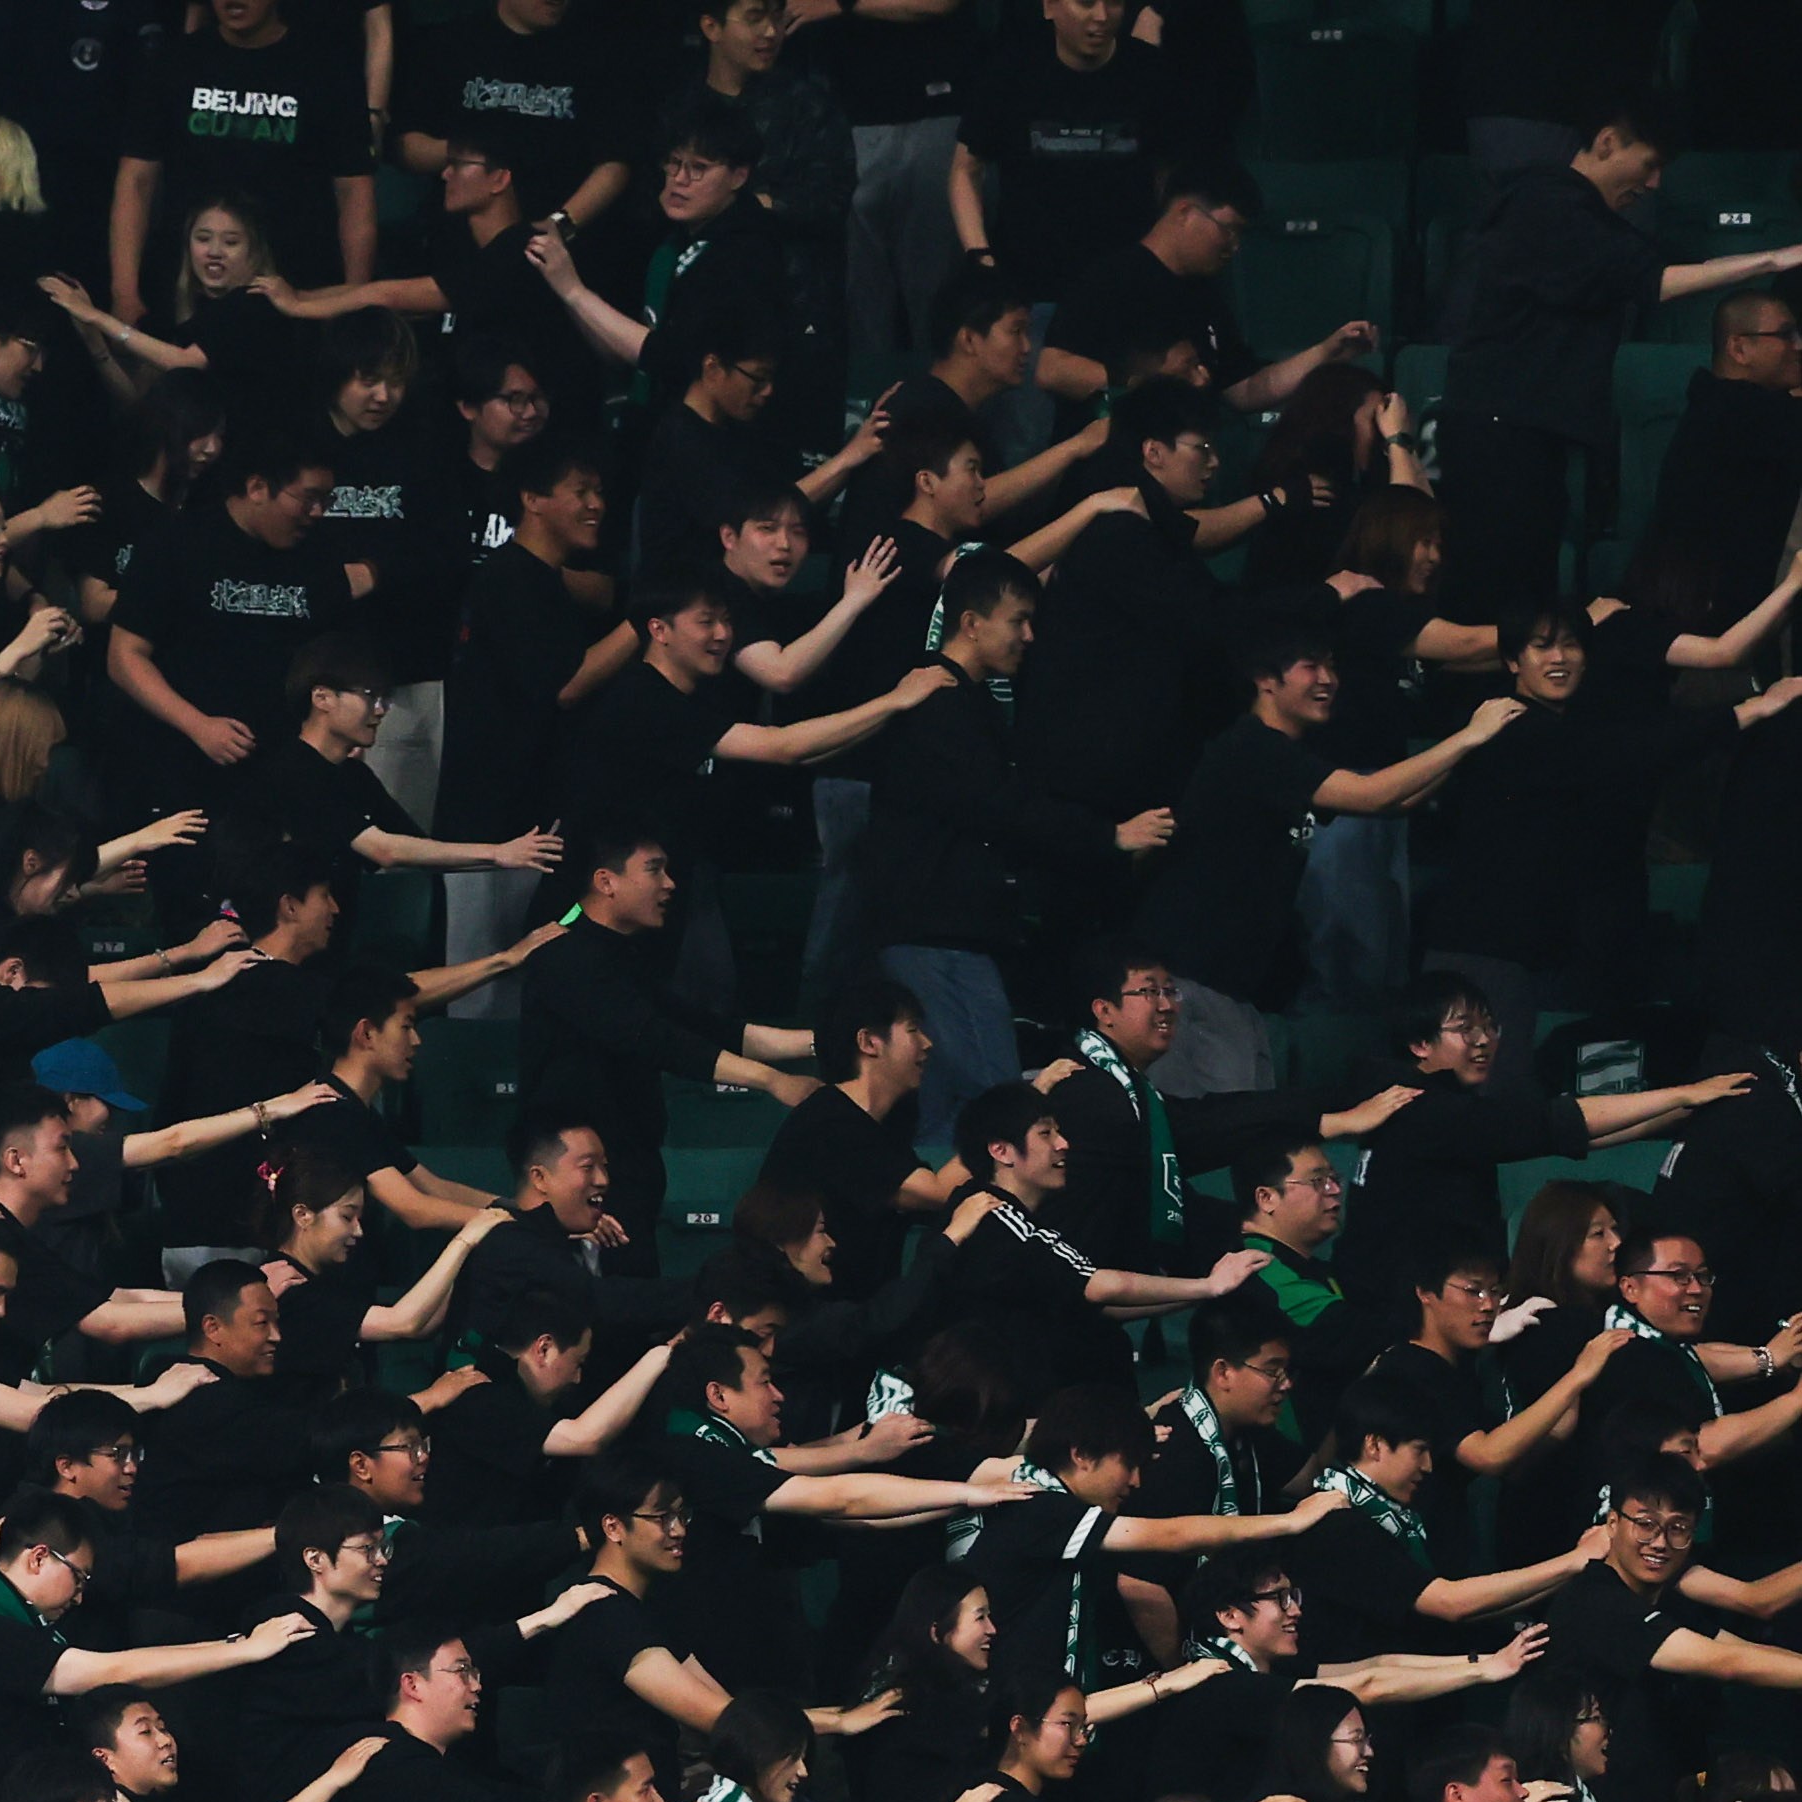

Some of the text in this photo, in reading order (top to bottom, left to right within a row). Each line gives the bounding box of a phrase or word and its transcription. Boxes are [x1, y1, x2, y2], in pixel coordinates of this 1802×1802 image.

[192, 87, 299, 118] BEIJING
[189, 111, 296, 144] GUAN
[695, 1213, 712, 1222] 20
